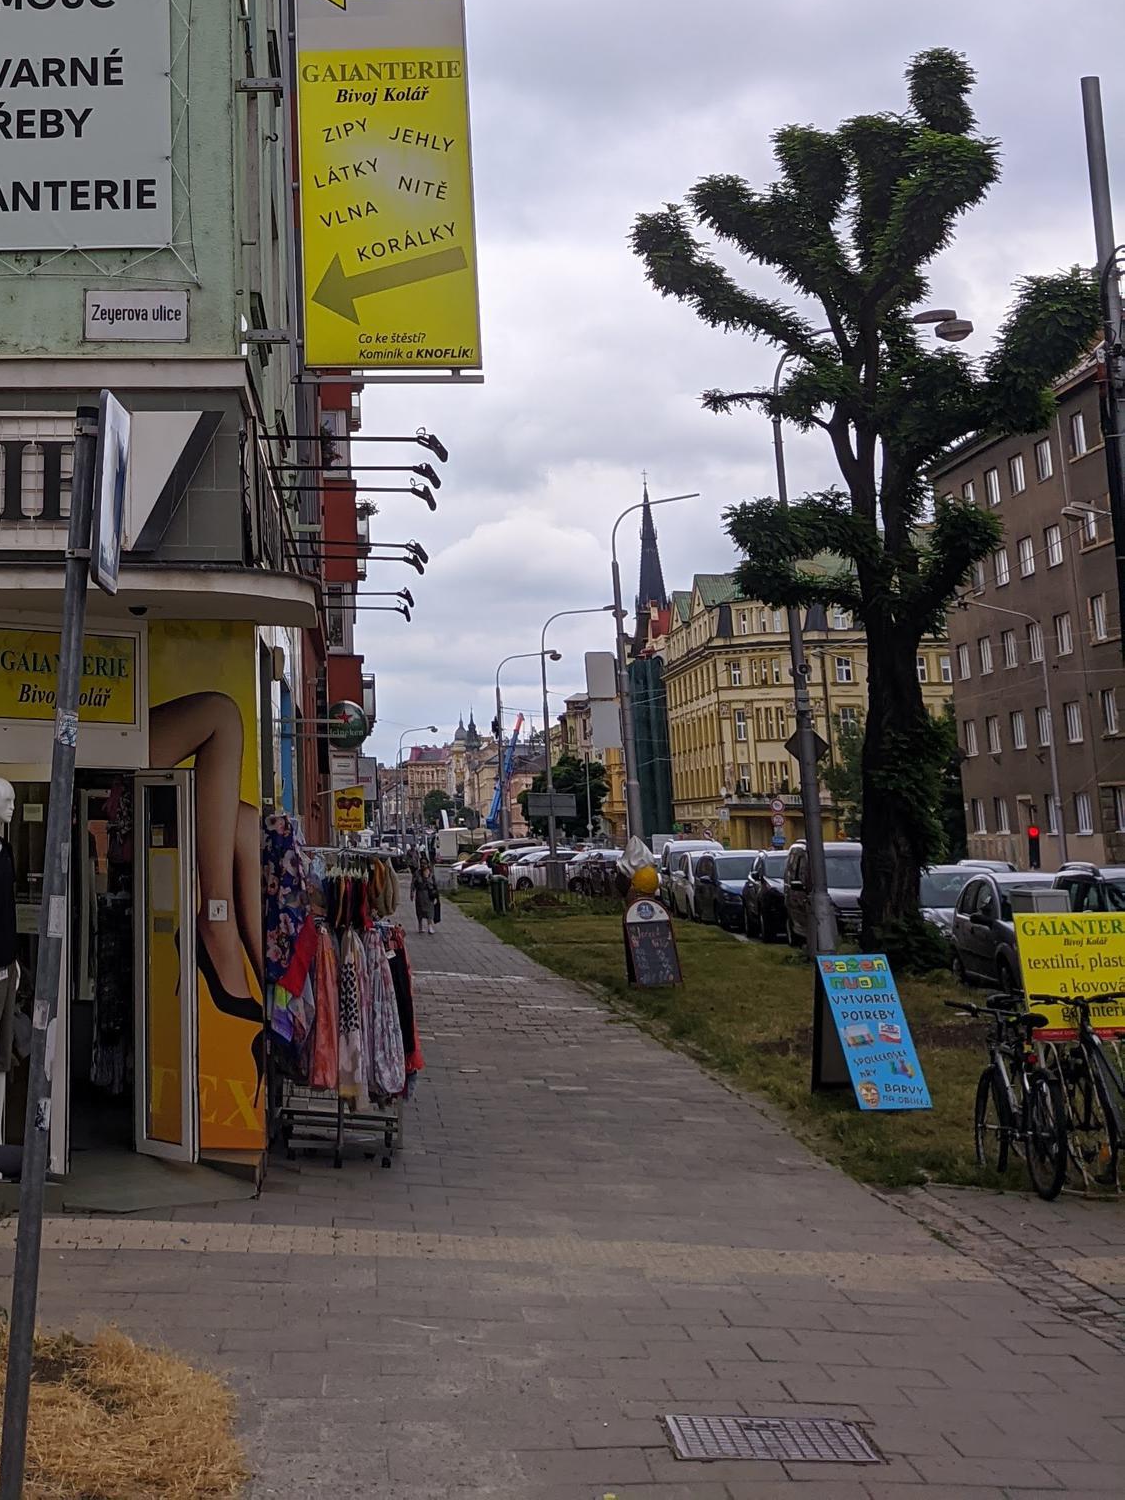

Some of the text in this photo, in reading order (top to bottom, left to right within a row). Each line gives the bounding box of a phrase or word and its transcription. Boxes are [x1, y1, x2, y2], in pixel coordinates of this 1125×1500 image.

[302, 60, 462, 83] GALANTERIE
[335, 86, 430, 105] Bivoj Kolář
[322, 117, 369, 143] ZIPY
[389, 126, 455, 152] JEHLY
[313, 157, 379, 189] LÁTKY
[398, 175, 448, 200] NITĚ
[319, 201, 379, 228] VLNA
[357, 222, 456, 262] KORÁLKY
[91, 303, 182, 325] Zeyerova ulice
[358, 333, 373, 344] Co
[375, 332, 388, 344] ke
[359, 349, 403, 359] Kominík
[406, 350, 413, 358] a
[0, 650, 129, 678] GALAERIE
[78, 687, 111, 707] olář
[1028, 953, 1085, 971] textilní,
[1059, 982, 1068, 993] a
